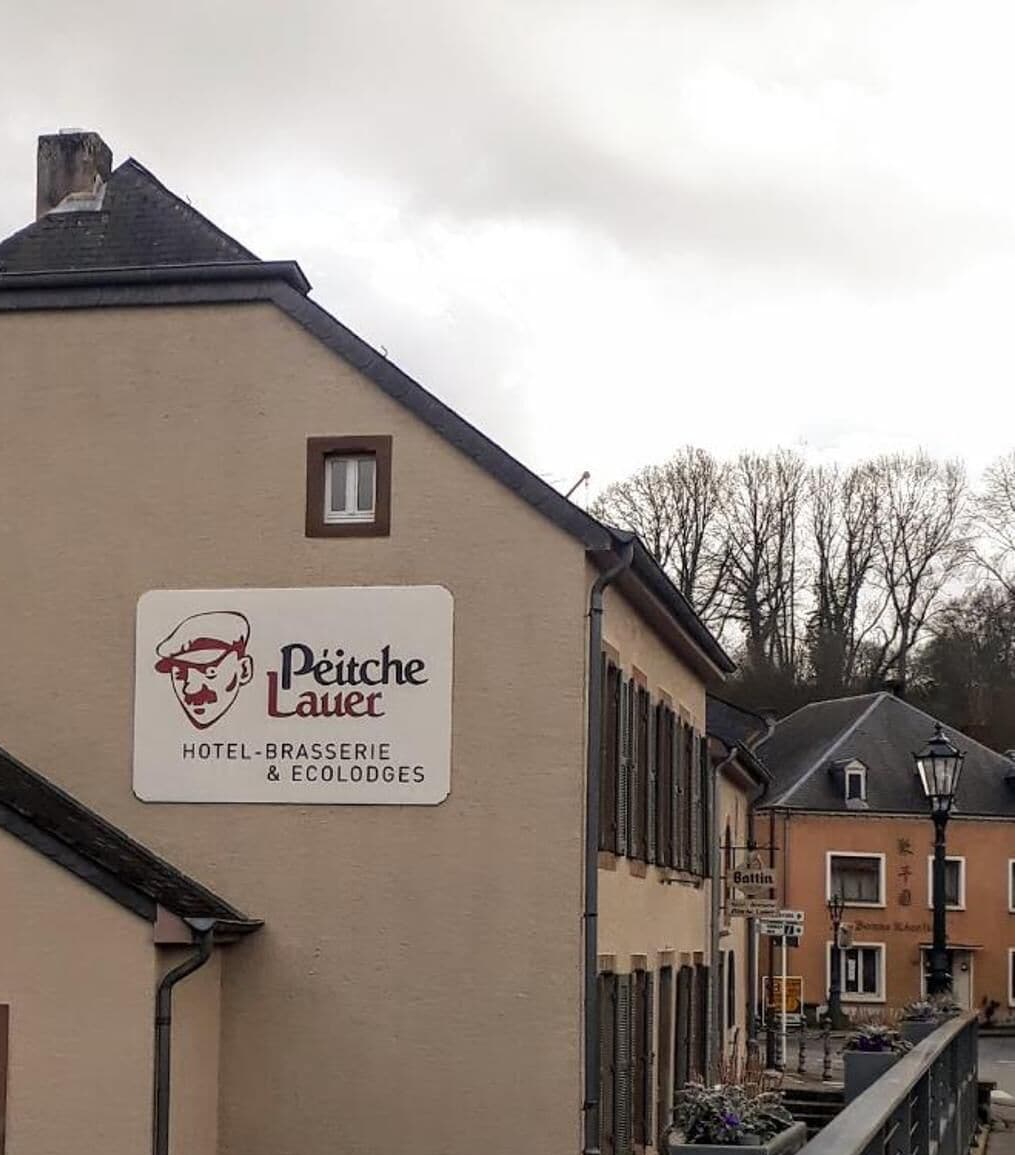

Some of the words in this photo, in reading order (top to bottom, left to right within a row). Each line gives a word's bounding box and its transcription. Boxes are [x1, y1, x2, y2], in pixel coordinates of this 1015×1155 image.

[280, 642, 429, 690] Péitche
[266, 671, 386, 718] Lauer
[182, 743, 391, 760] HOTEL-BRASSERIE
[266, 765, 280, 782] &
[291, 765, 426, 783] ECOLODGES
[733, 871, 773, 884] Battin
